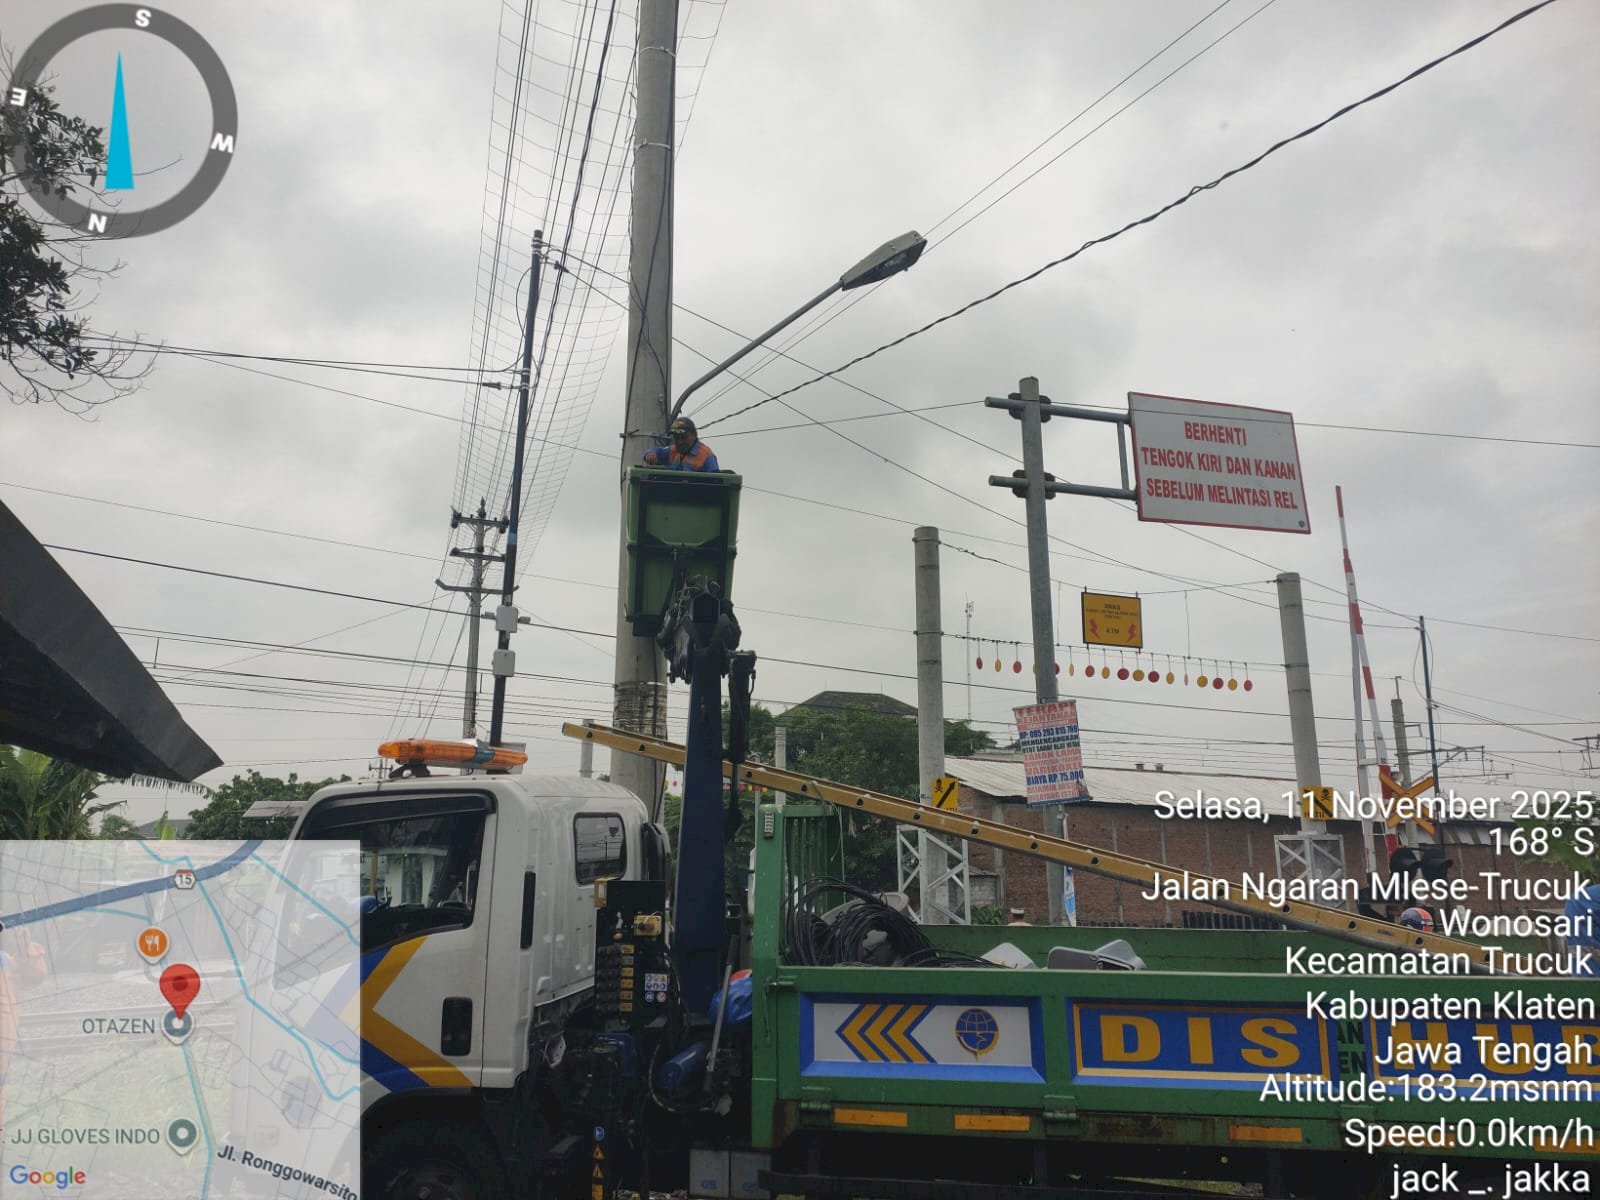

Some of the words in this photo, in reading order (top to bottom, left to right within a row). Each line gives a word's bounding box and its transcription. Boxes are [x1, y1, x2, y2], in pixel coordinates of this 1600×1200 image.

[1184, 421, 1247, 447] BERHENTI
[1141, 447, 1194, 470] TENGOK
[1197, 452, 1222, 473] KIRI
[1226, 456, 1251, 476] DAN
[1255, 459, 1296, 481] KANAN
[1146, 478, 1204, 500] SEBELUM
[1207, 484, 1271, 508] MELINTASI
[1274, 491, 1298, 510] REL
[1026, 775, 1047, 785] BIAYA
